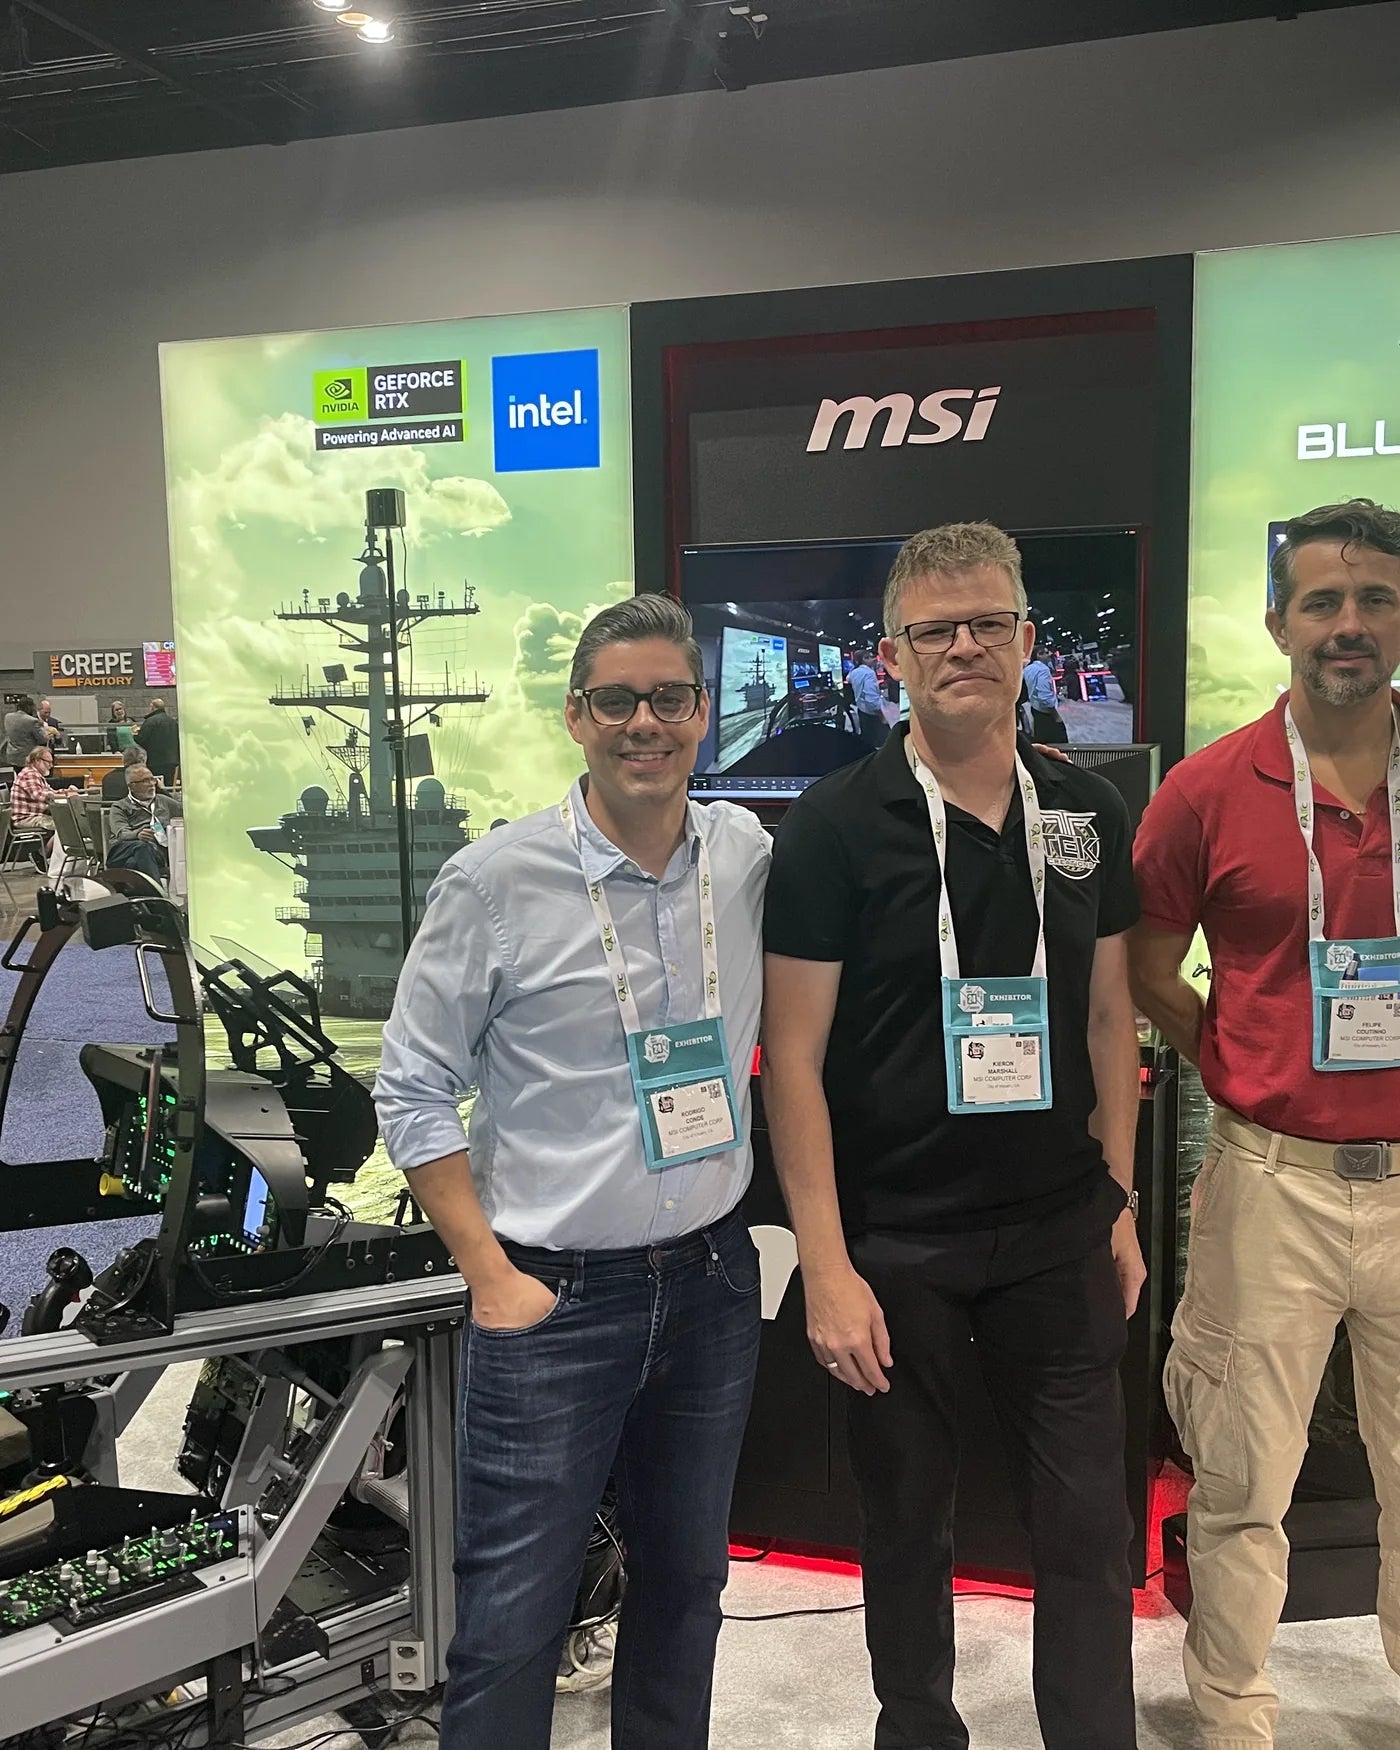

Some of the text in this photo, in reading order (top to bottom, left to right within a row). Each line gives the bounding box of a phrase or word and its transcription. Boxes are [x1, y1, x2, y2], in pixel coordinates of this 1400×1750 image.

[374, 370, 454, 391] GEFORCE
[375, 392, 409, 410] RTX
[806, 386, 1001, 452] msi
[322, 425, 456, 445] Powering Advanced AI
[50, 655, 60, 676] THE
[60, 652, 134, 676] CREPE
[77, 677, 133, 686] FACTORY
[675, 1034, 713, 1048] EXHIBITOR
